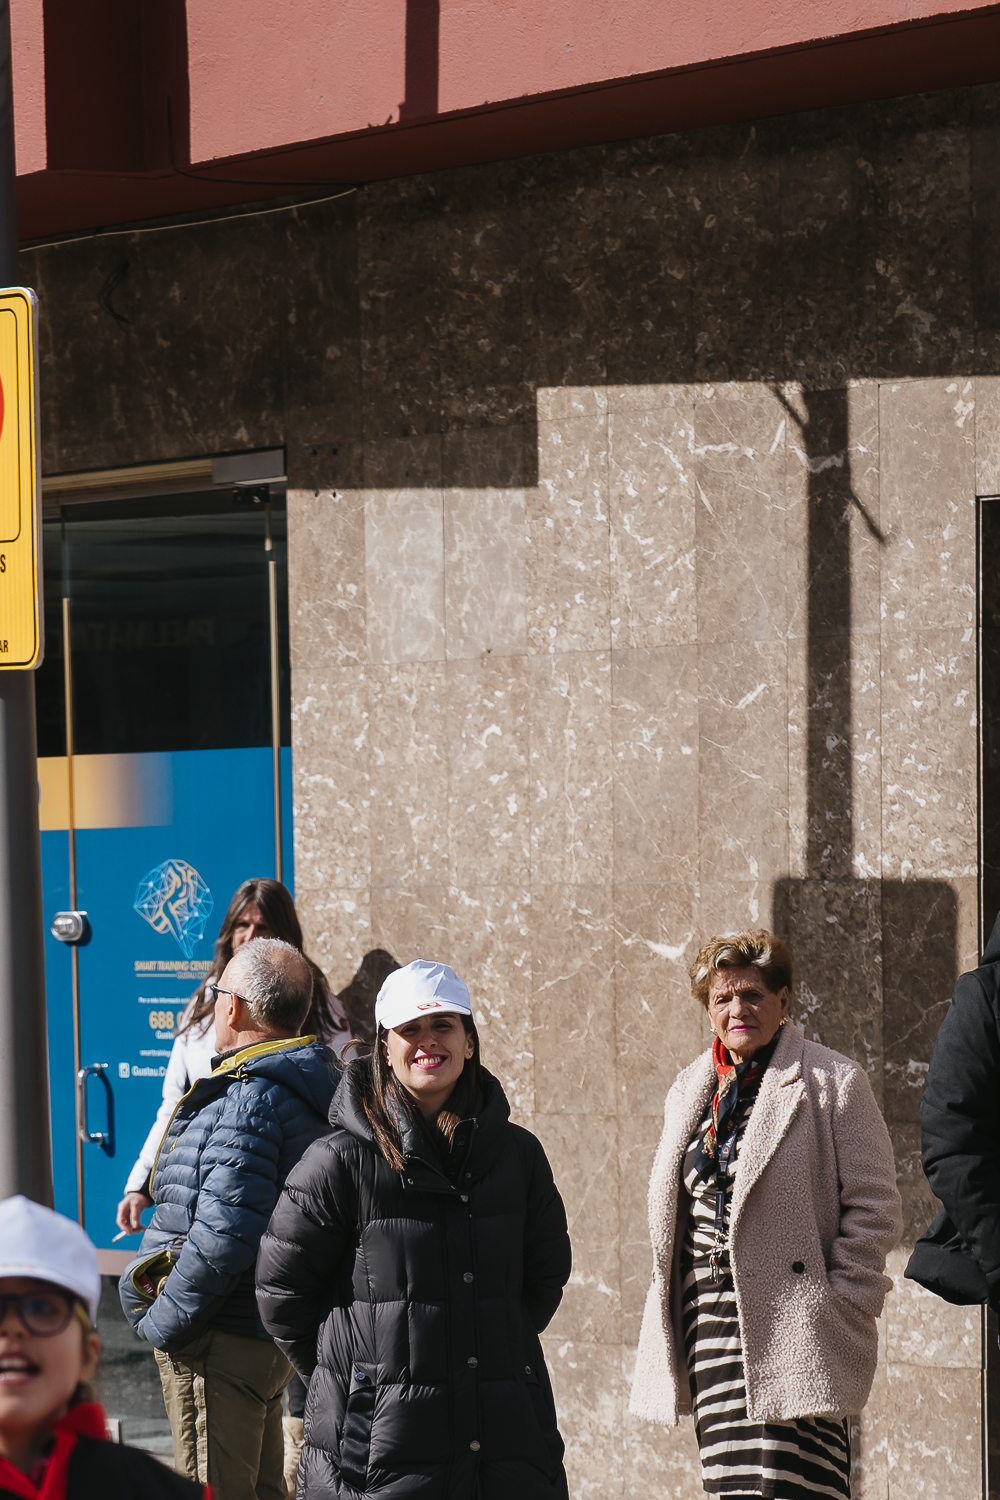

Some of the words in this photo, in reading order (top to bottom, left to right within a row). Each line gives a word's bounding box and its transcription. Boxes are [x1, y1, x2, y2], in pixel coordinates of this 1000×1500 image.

[134, 960, 157, 972] SMART
[157, 960, 189, 972] TRAINING
[149, 1010, 175, 1030] 688
